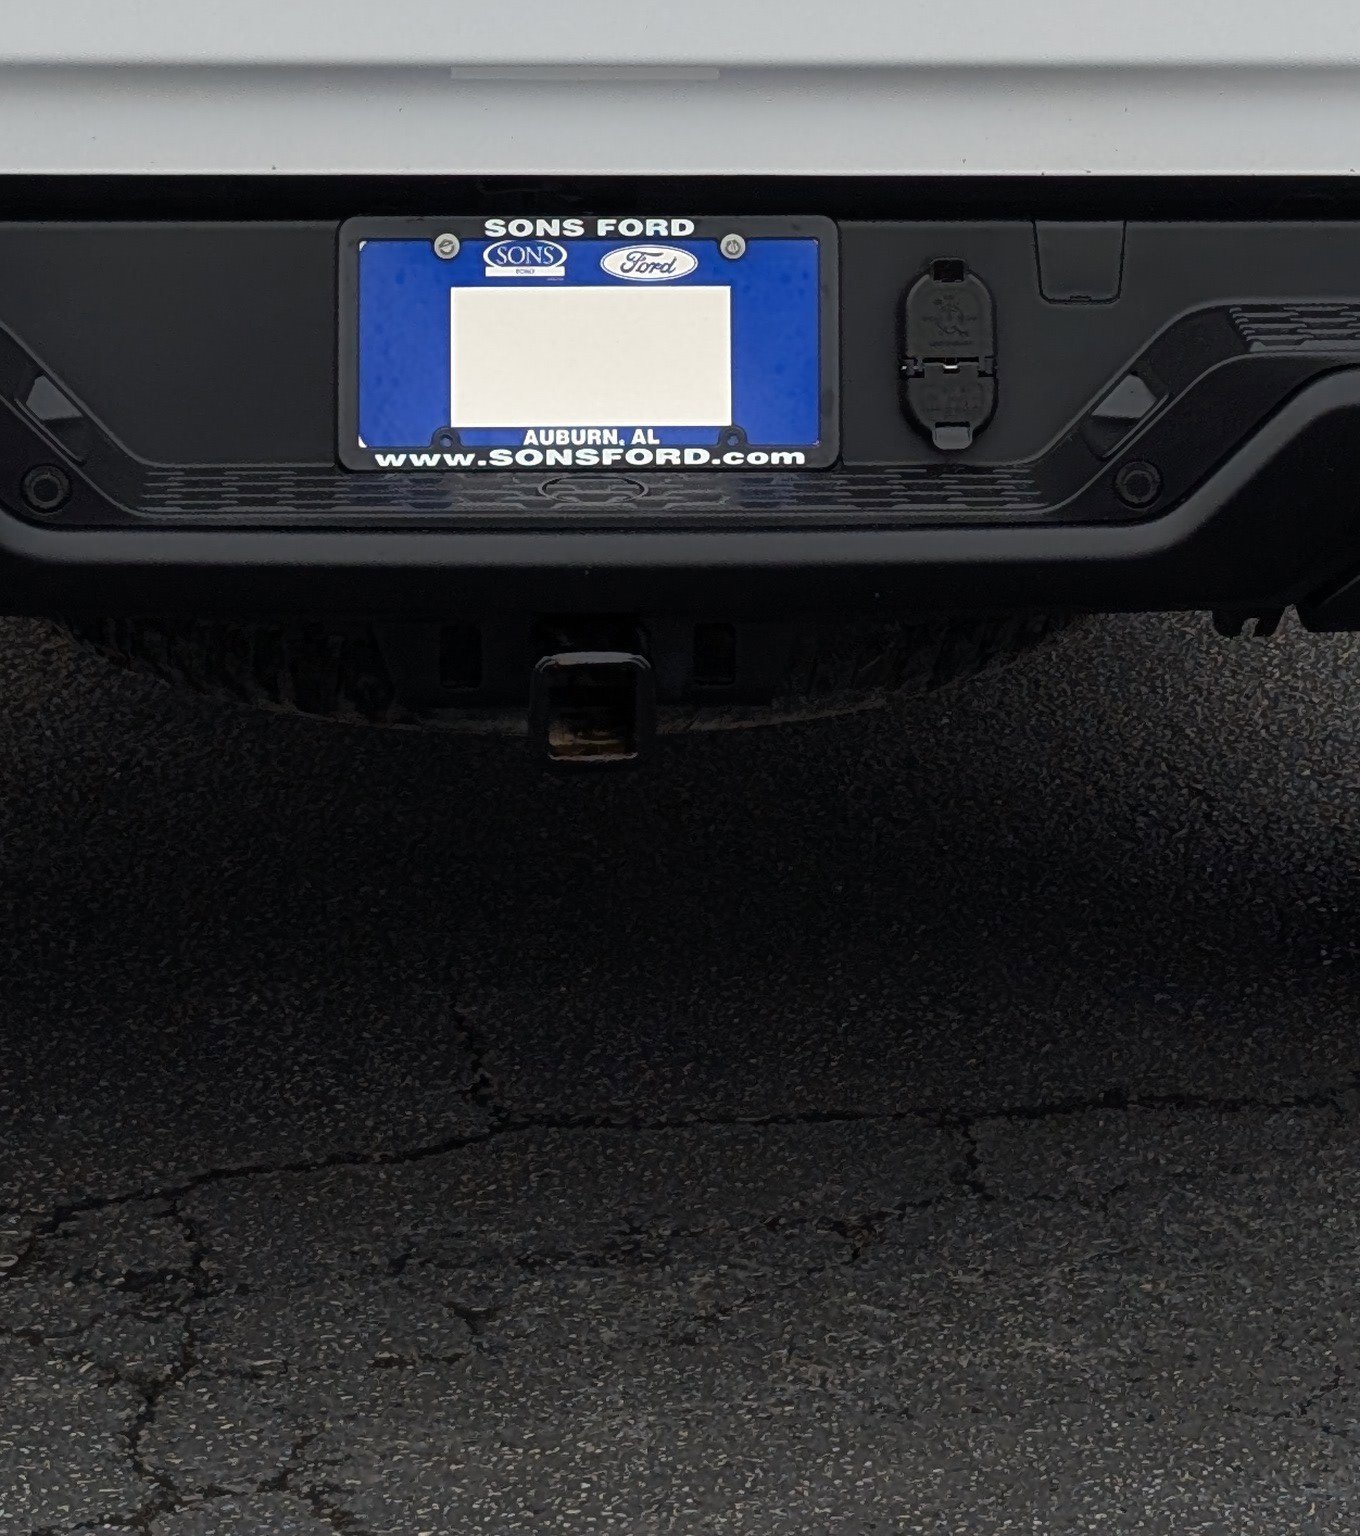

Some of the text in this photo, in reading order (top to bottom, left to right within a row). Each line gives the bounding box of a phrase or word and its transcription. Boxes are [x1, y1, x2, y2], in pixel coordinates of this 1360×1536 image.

[484, 219, 695, 237] SONS FORD
[496, 246, 555, 265] SONS
[620, 251, 678, 275] Ford
[631, 430, 660, 445] AL
[374, 448, 806, 466] www.SONSFORD.com
